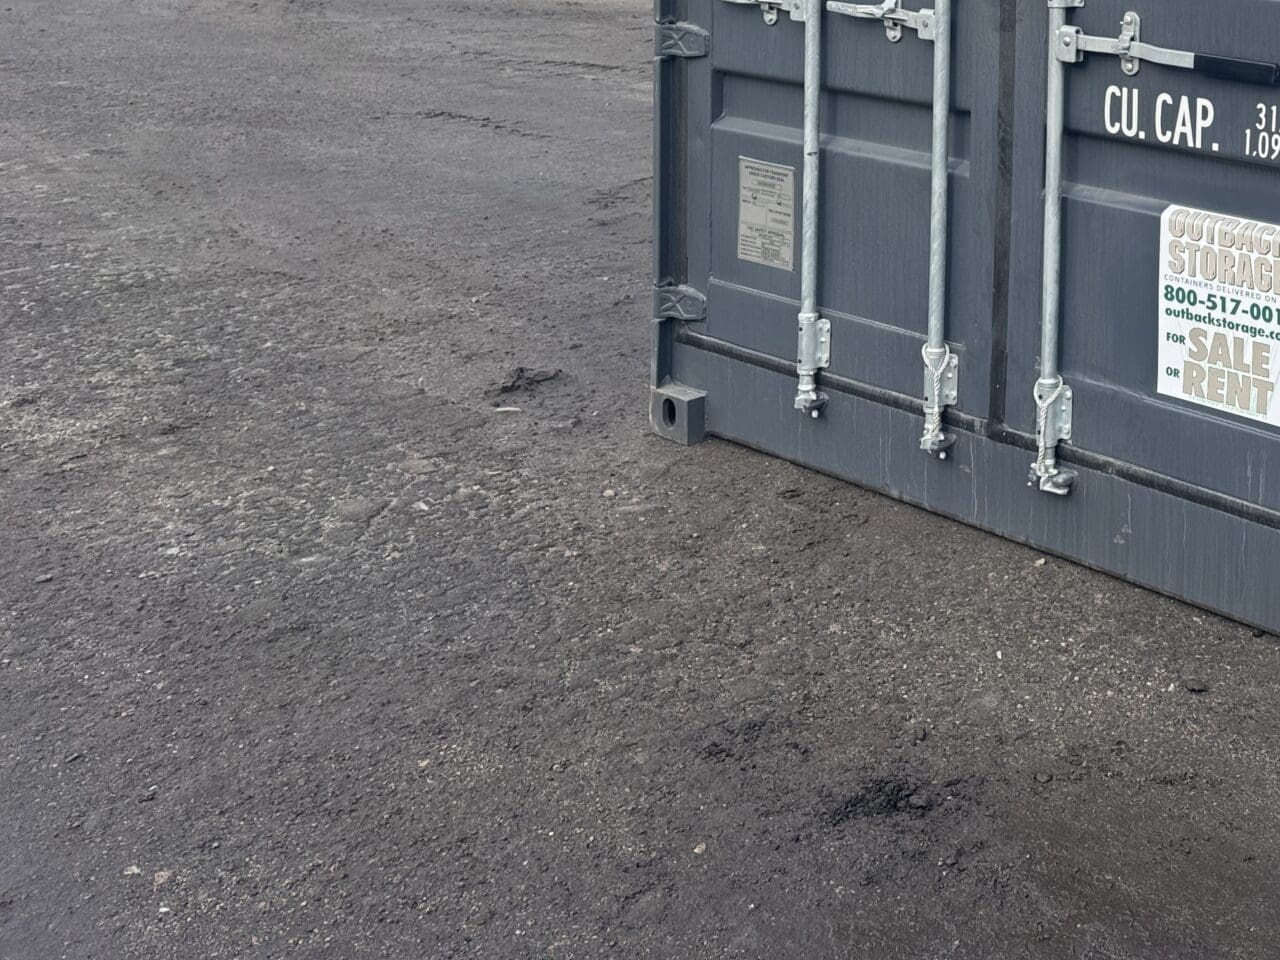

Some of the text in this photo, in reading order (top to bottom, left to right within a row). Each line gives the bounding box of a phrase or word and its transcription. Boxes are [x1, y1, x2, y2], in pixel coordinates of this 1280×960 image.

[1103, 84, 1146, 140] CU.
[1154, 92, 1220, 152] CAP.
[1163, 273, 1214, 290] CONTAINERS
[1216, 284, 1262, 301] DELIVERED
[1264, 295, 1277, 304] ON
[1166, 327, 1271, 379] FOR SALE
[1165, 366, 1180, 379] OR
[1182, 360, 1275, 415] RENT
